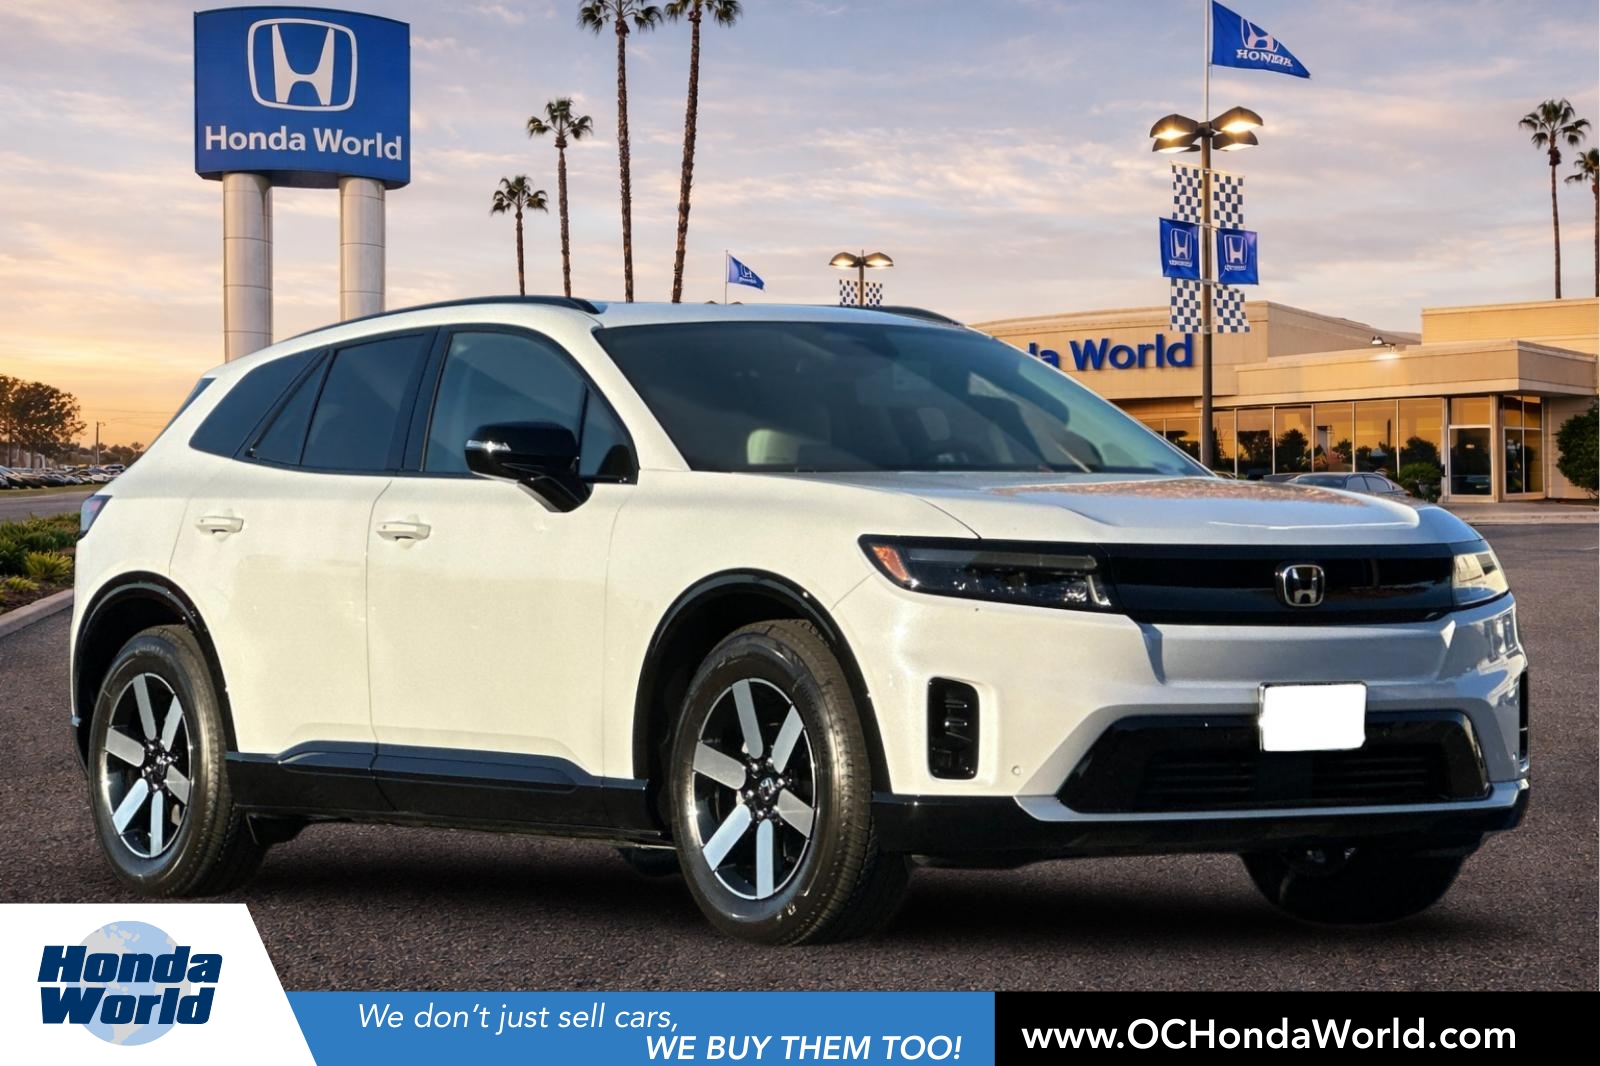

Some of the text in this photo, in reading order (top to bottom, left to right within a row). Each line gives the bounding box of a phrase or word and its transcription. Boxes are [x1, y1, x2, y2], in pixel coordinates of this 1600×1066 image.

[205, 125, 402, 161] Honda World
[1070, 334, 1193, 370] World
